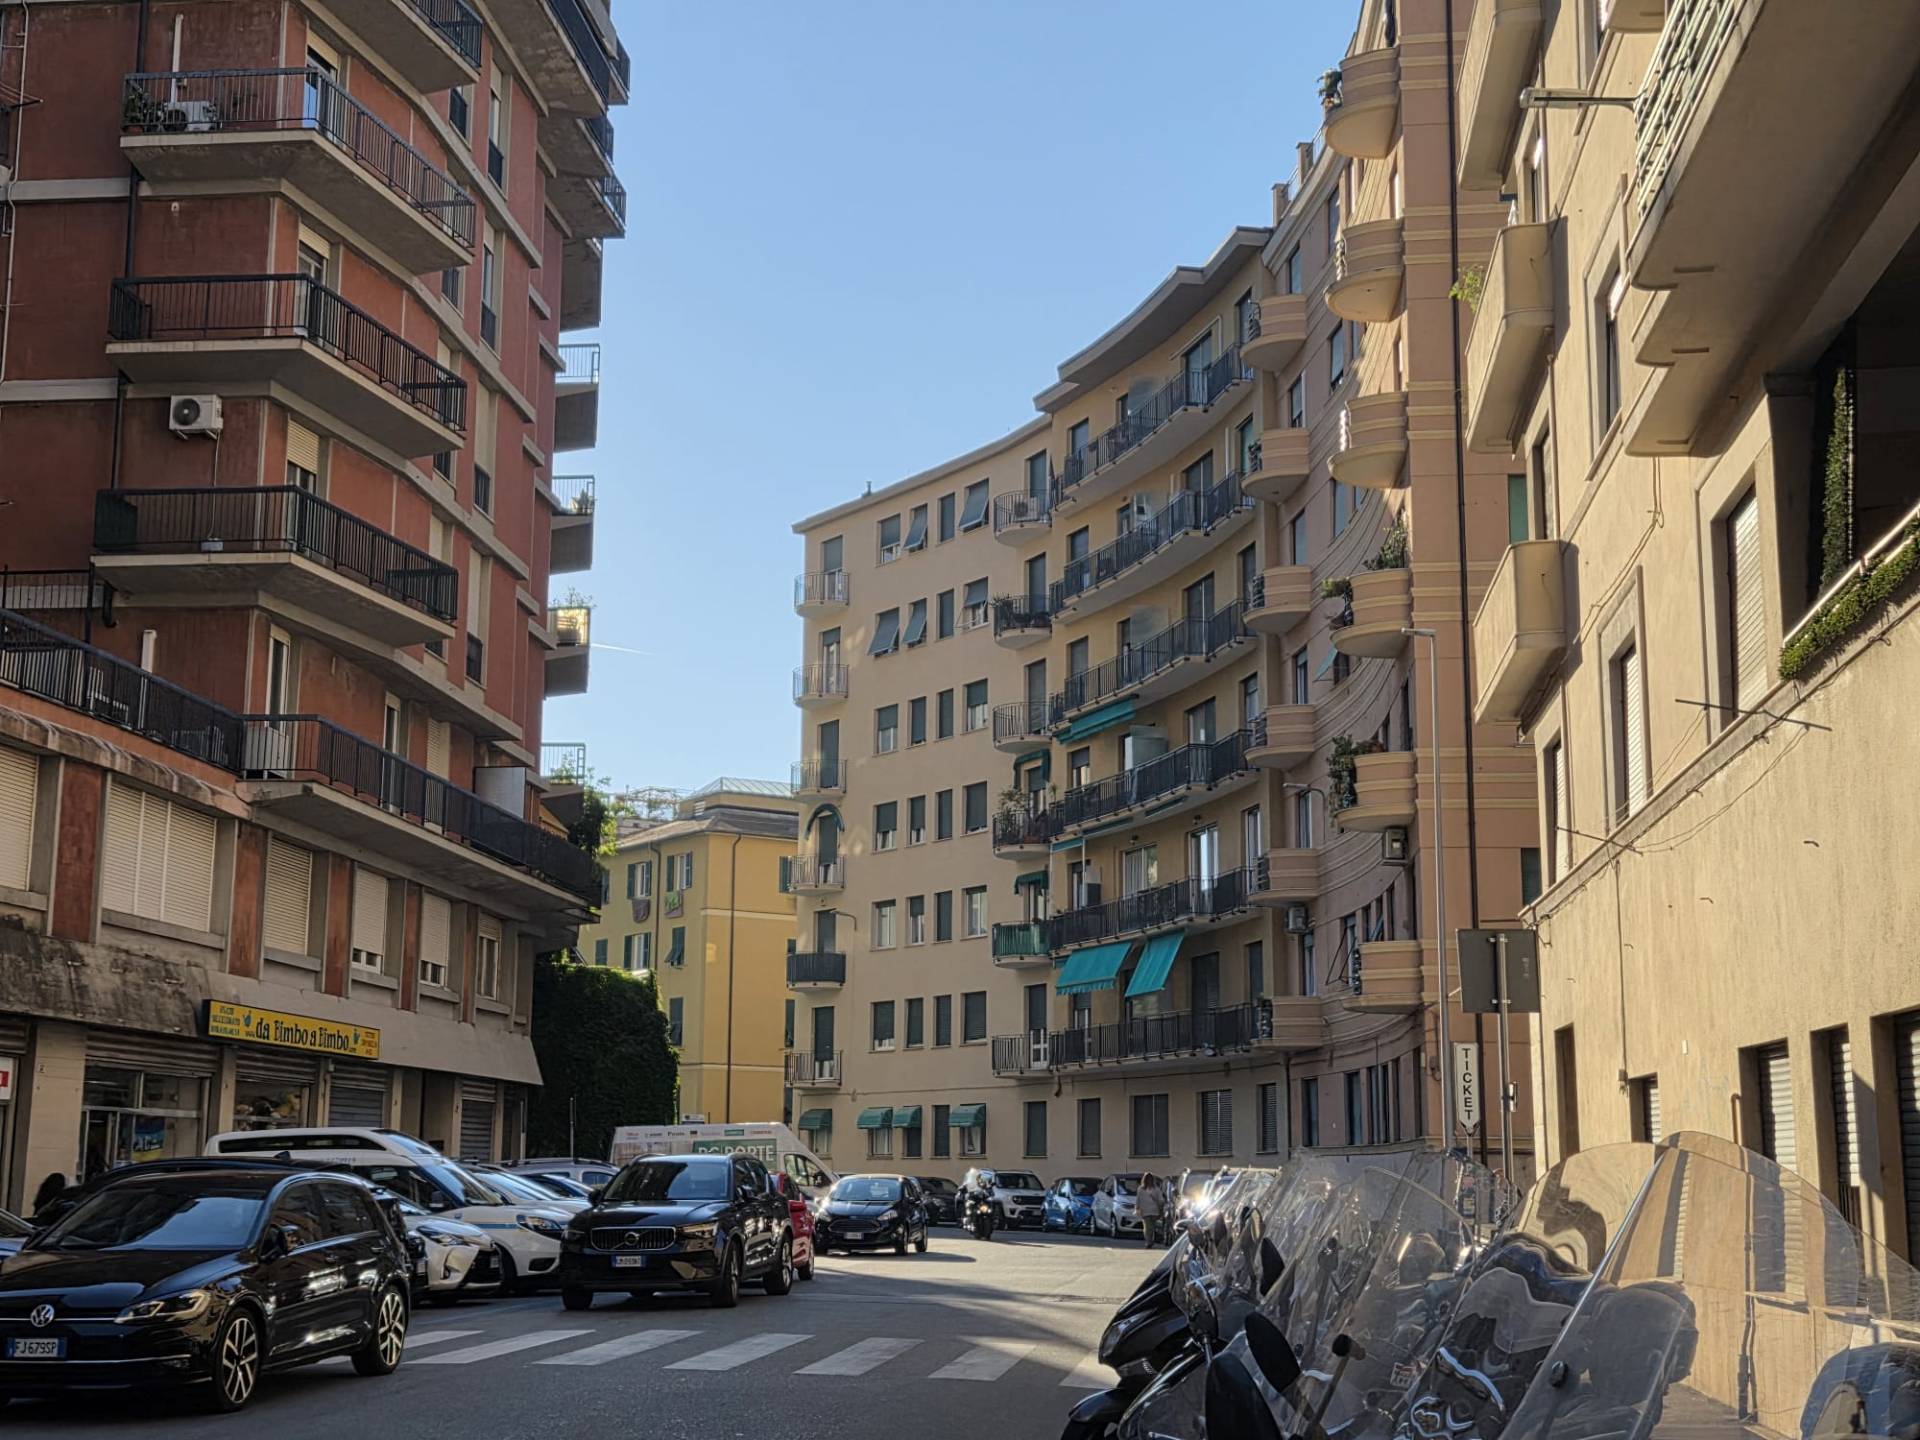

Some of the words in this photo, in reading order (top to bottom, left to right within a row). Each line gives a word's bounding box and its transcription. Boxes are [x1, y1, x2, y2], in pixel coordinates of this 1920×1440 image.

[255, 1017, 270, 1041] da
[310, 1029, 317, 1047] a
[1462, 1048, 1473, 1120] TICKET
[16, 1341, 57, 1354] FJ679SP
